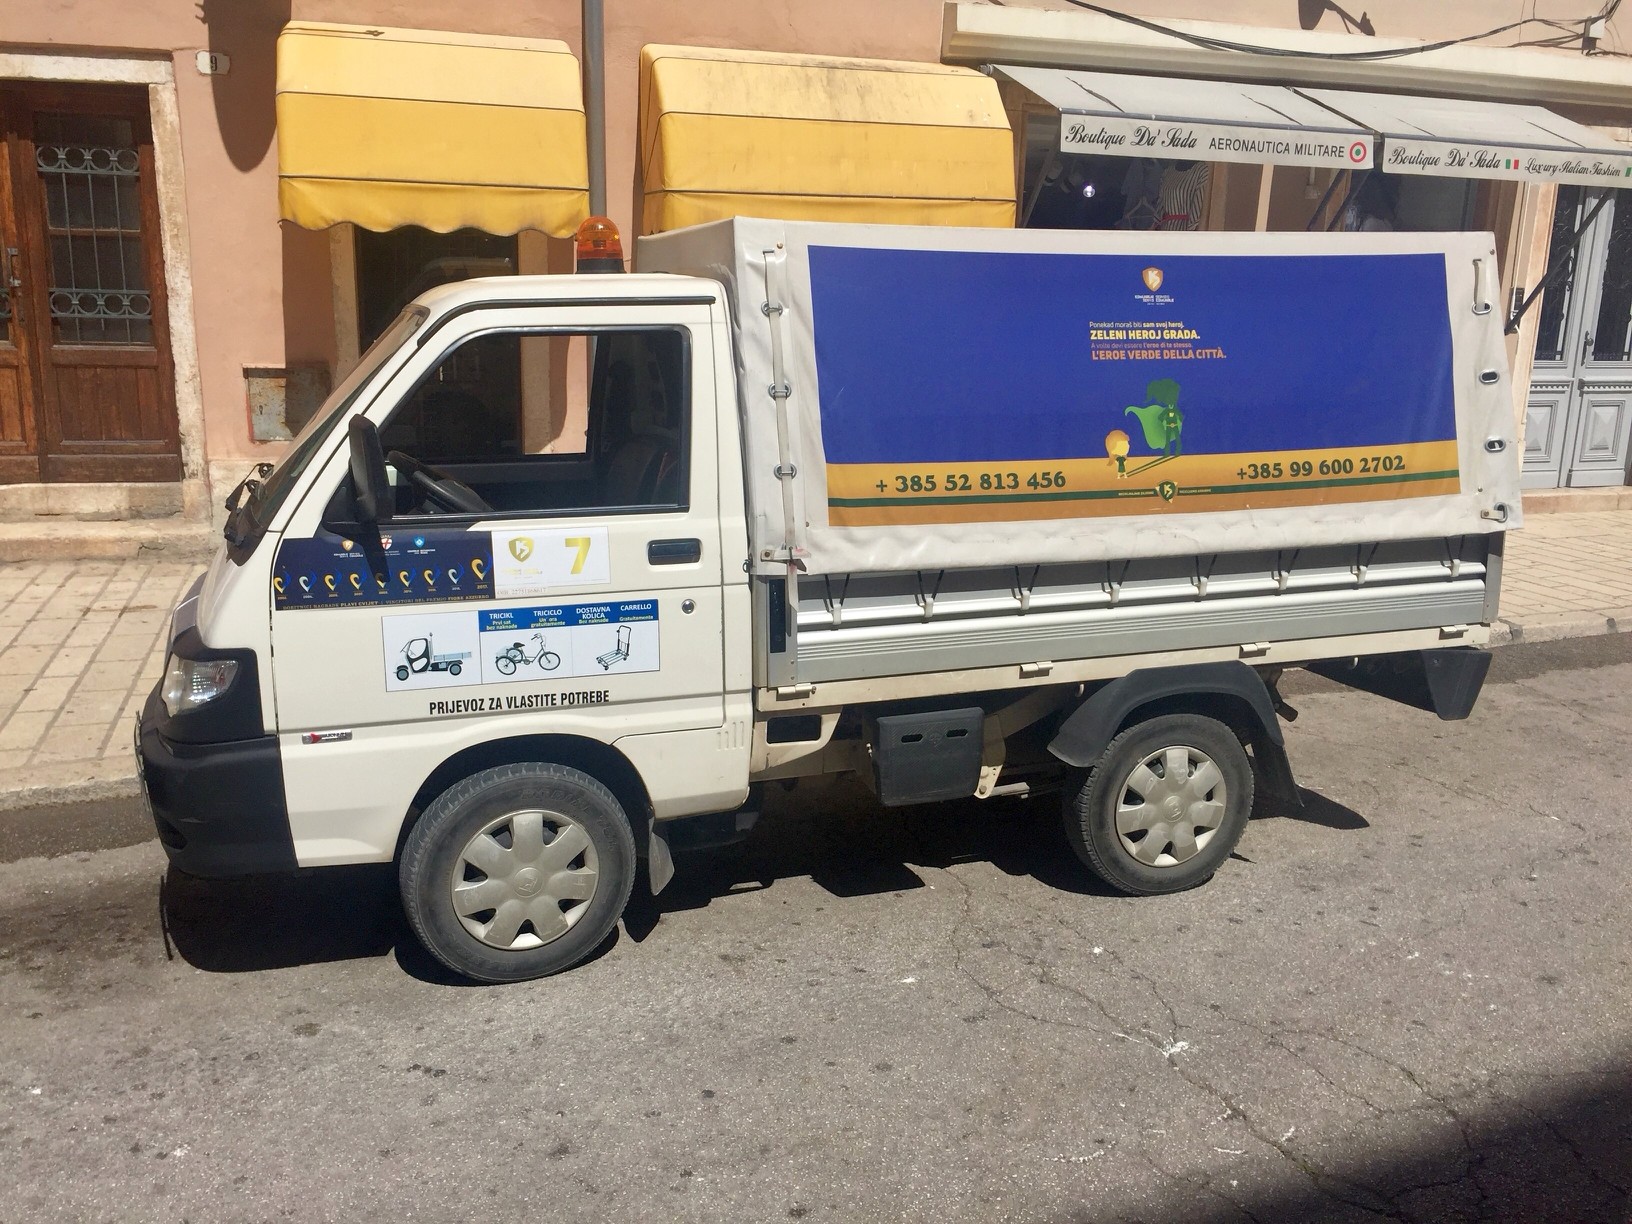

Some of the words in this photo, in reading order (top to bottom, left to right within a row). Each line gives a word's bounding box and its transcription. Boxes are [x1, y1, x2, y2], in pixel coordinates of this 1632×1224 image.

[210, 55, 218, 72] 9
[1065, 123, 1127, 150] Boutique
[1161, 128, 1198, 148] Sada
[1209, 138, 1290, 154] AERONAUTICA
[1294, 143, 1345, 158] MILITARE
[1389, 146, 1441, 170] Boutique
[1470, 150, 1501, 168] Sada
[1525, 158, 1558, 176] Luxury
[1559, 160, 1588, 174] Italian
[1590, 162, 1621, 176] Fashion
[1090, 330, 1126, 340] ZELENI
[1128, 330, 1161, 340] HEROJ
[1163, 330, 1200, 339] GRADA.
[1092, 350, 1126, 360] L'EROE
[1128, 350, 1162, 360] VERDE
[1163, 349, 1194, 360] DELLA
[1196, 346, 1227, 358] CITTÀ.
[1236, 462, 1283, 480] +385
[1289, 460, 1313, 477] 99
[1318, 458, 1354, 476] 600
[1359, 455, 1406, 472] 2702
[895, 475, 937, 492] 385
[944, 474, 972, 492] 52
[980, 472, 1020, 490] 813
[1026, 471, 1066, 490] 456
[564, 537, 592, 575] 7
[576, 606, 611, 614] DOSTAVNA
[430, 698, 484, 714] PRIJEVOZ
[488, 698, 502, 710] ZA
[506, 694, 556, 709] VLASTITE
[560, 690, 610, 706] POTREBE
